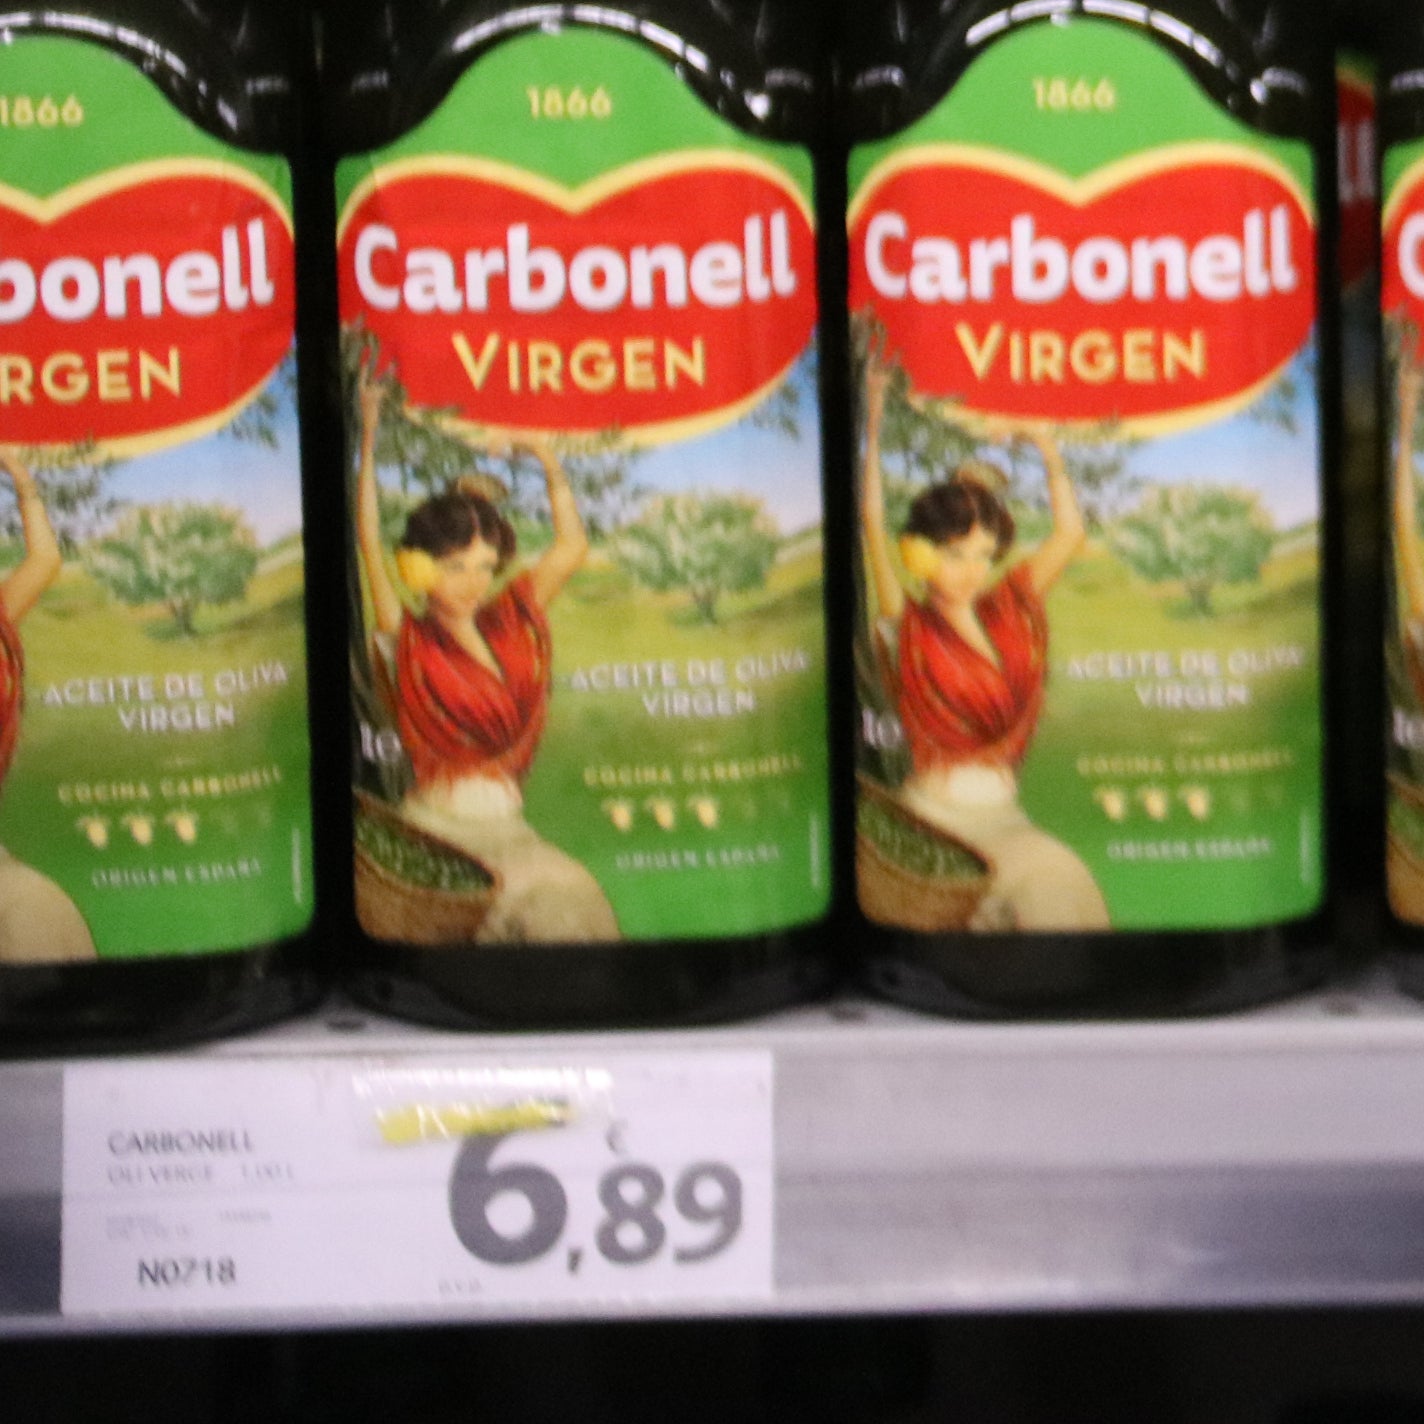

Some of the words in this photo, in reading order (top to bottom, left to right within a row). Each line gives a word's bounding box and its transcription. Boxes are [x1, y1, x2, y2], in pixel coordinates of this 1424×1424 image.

[526, 86, 612, 121] 1866
[1032, 77, 1117, 111] 1866
[355, 209, 797, 314] Carbonell
[864, 203, 1297, 304] Carbonell
[0, 345, 181, 405] RGEN
[452, 331, 705, 394] VIRGEN
[955, 322, 1205, 384] VIRGEN
[44, 674, 154, 707] ACEITE
[164, 673, 204, 701] DE
[215, 660, 289, 697] OLIVA
[571, 660, 678, 692] ACEITE
[688, 658, 727, 687] DE
[736, 648, 808, 684] OLIVA
[119, 703, 235, 732] VIRGEN
[642, 689, 756, 718] VIRGEN
[107, 1129, 254, 1155] CARBONELL
[448, 1104, 744, 1275] 6,89
